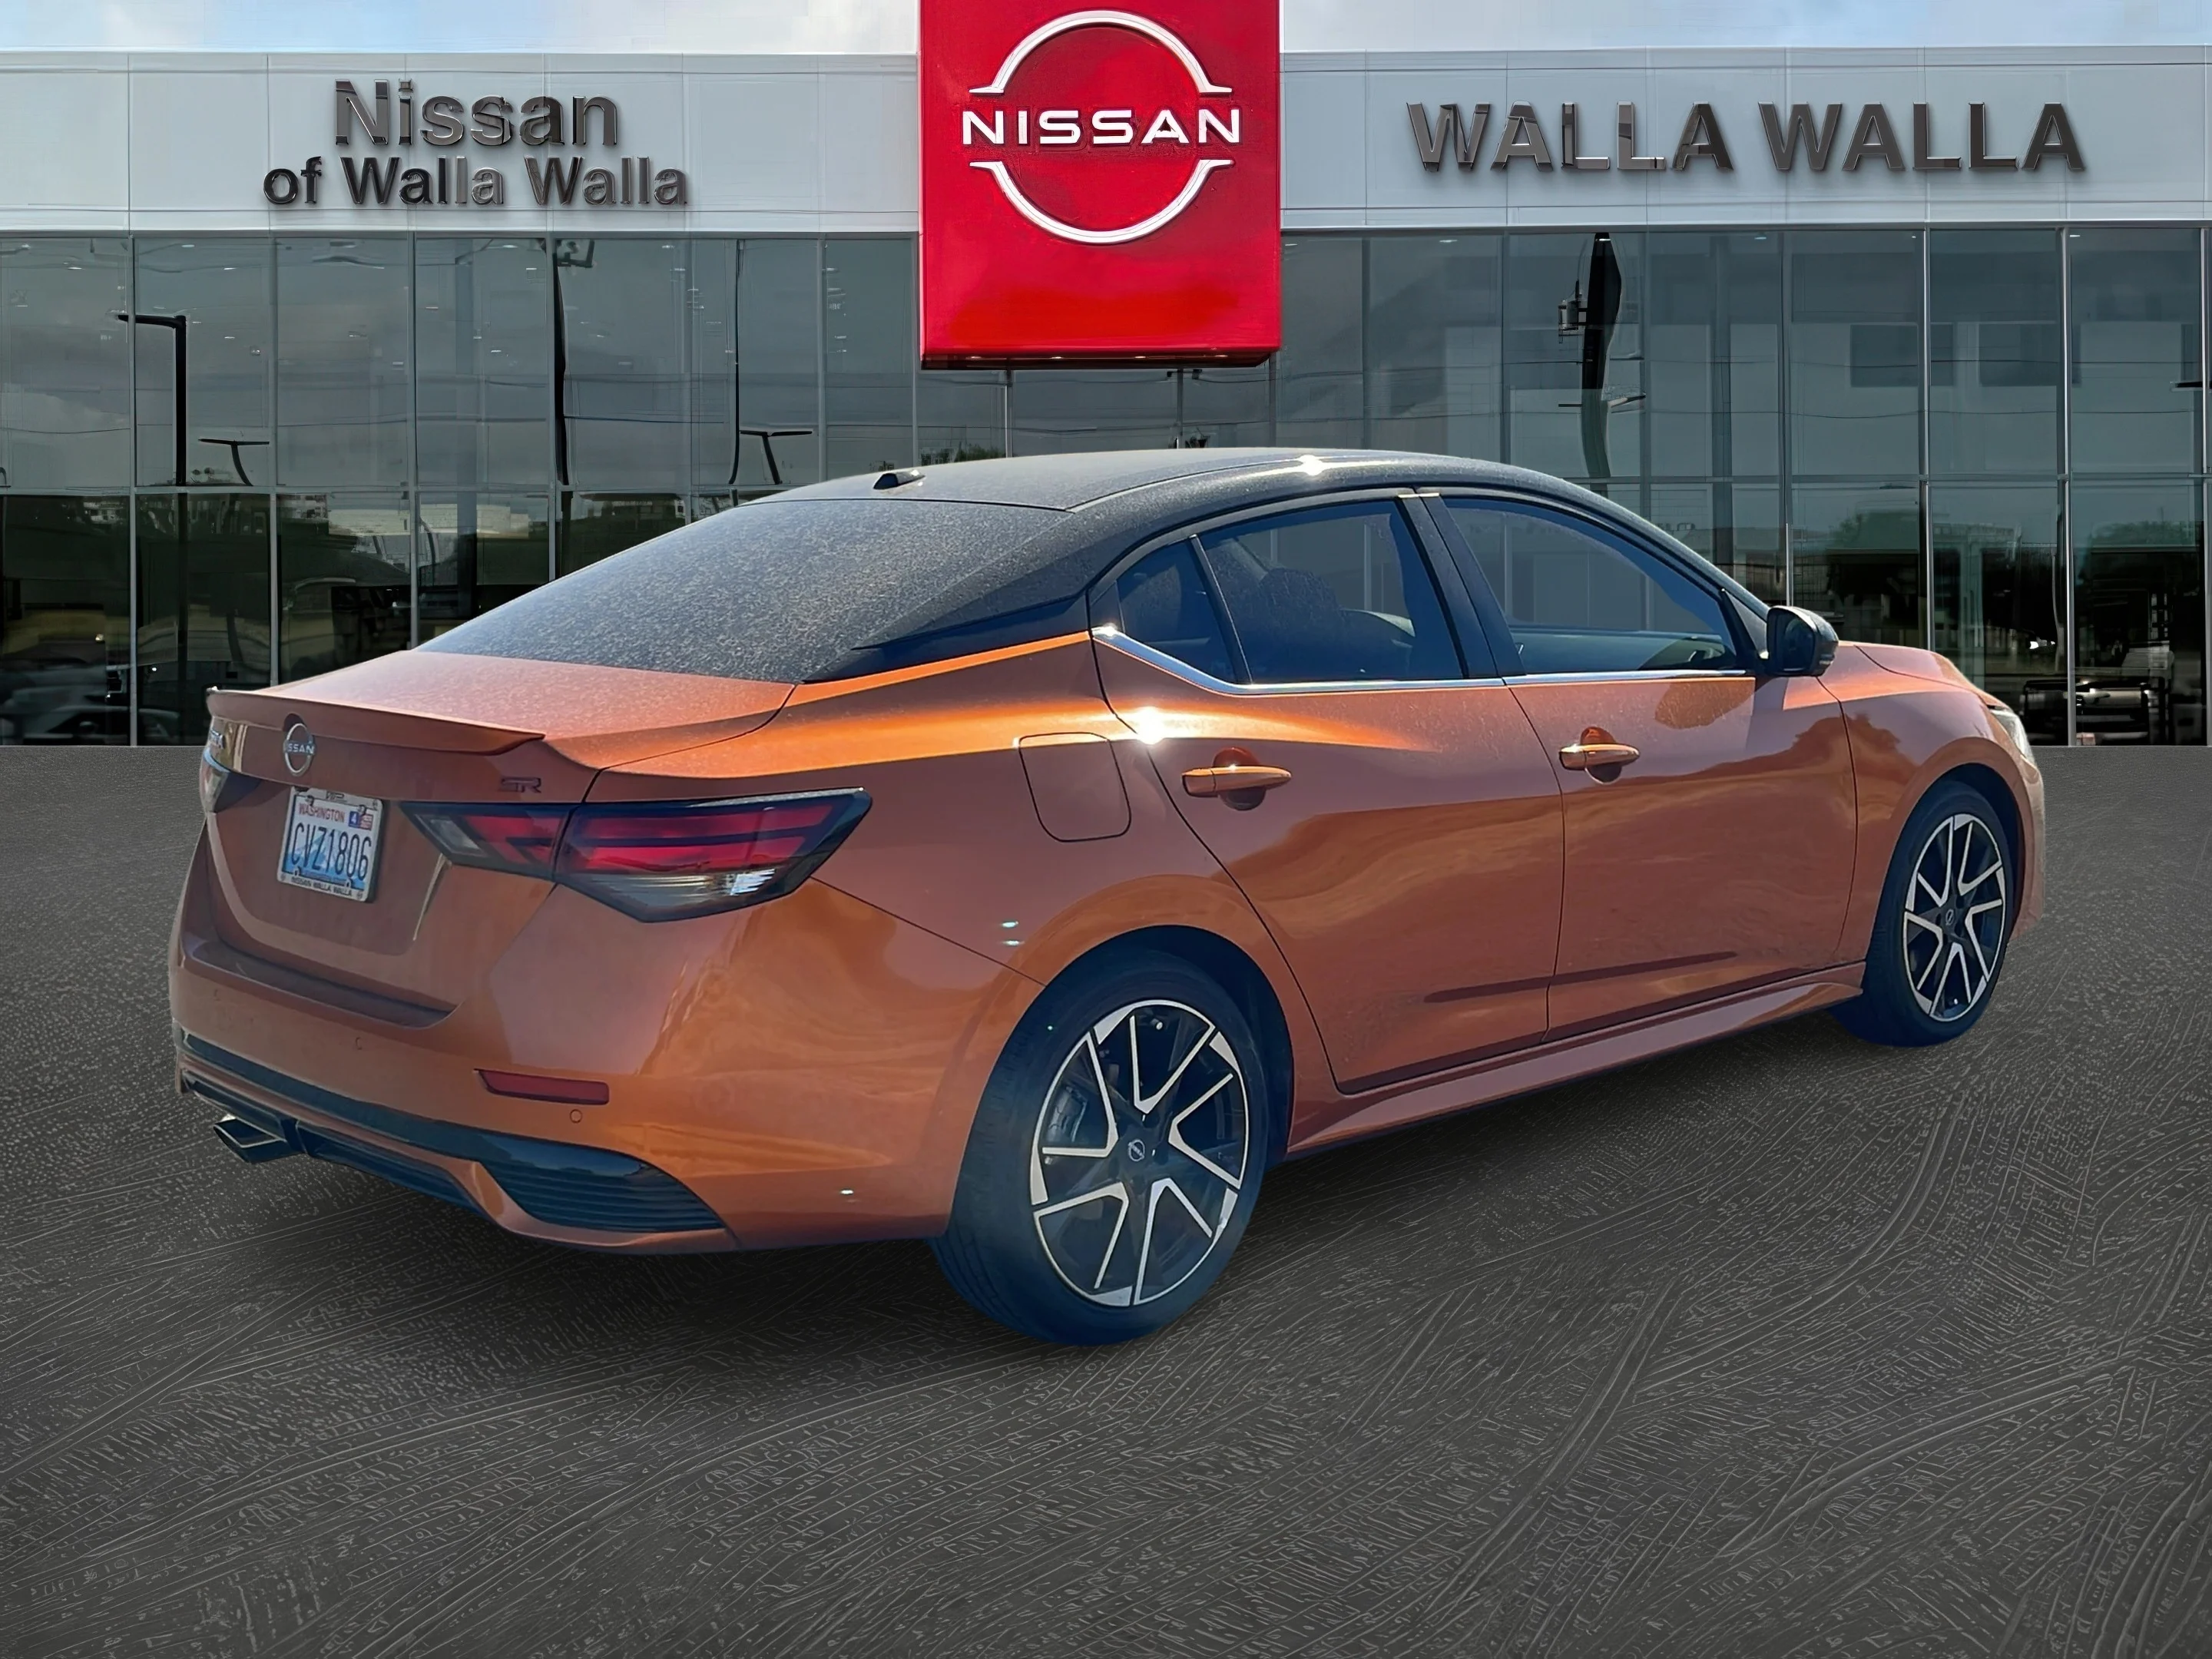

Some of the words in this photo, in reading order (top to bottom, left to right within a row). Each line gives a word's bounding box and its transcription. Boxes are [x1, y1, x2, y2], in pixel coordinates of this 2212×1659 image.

[334, 78, 619, 147] Nissan
[962, 109, 1240, 146] NISSAN
[1406, 101, 1736, 174] WALLA
[1757, 101, 2086, 174] WALLA
[263, 156, 324, 206] of
[338, 156, 507, 206] Walla
[523, 156, 689, 206] Walla
[299, 803, 346, 823] WASHINGTON
[291, 823, 372, 881] CVZ1806
